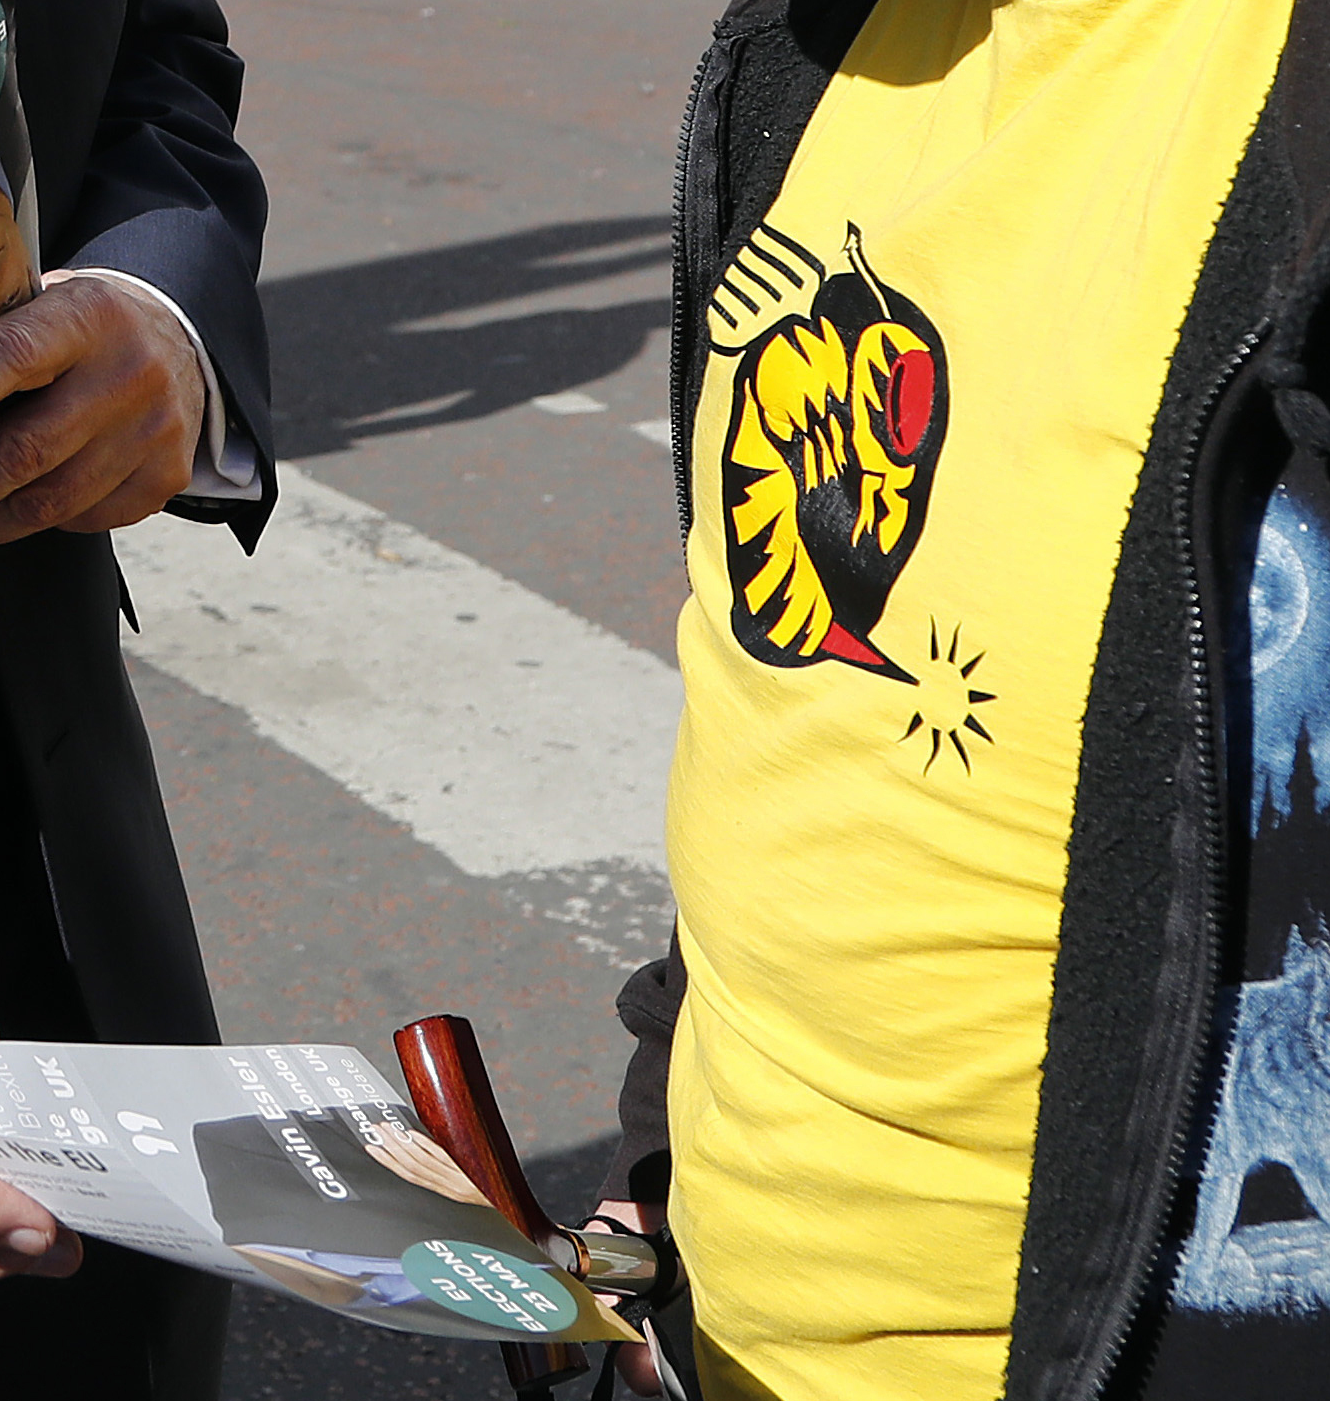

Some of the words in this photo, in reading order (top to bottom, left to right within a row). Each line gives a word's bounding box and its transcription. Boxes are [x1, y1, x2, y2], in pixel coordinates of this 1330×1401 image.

[33, 1054, 76, 1099] UK
[265, 1047, 323, 1118] London
[299, 1047, 329, 1073] UK
[228, 1056, 288, 1121] Esler
[326, 1075, 385, 1146] Change
[340, 1058, 413, 1145] Candidate
[5, 1139, 64, 1168] the
[60, 1148, 108, 1173] EU
[280, 1127, 349, 1200] Gavin
[423, 1239, 549, 1334] ELECTIONS
[430, 1277, 473, 1302] EU
[470, 1252, 531, 1291] MAY
[521, 1290, 560, 1314] 23
